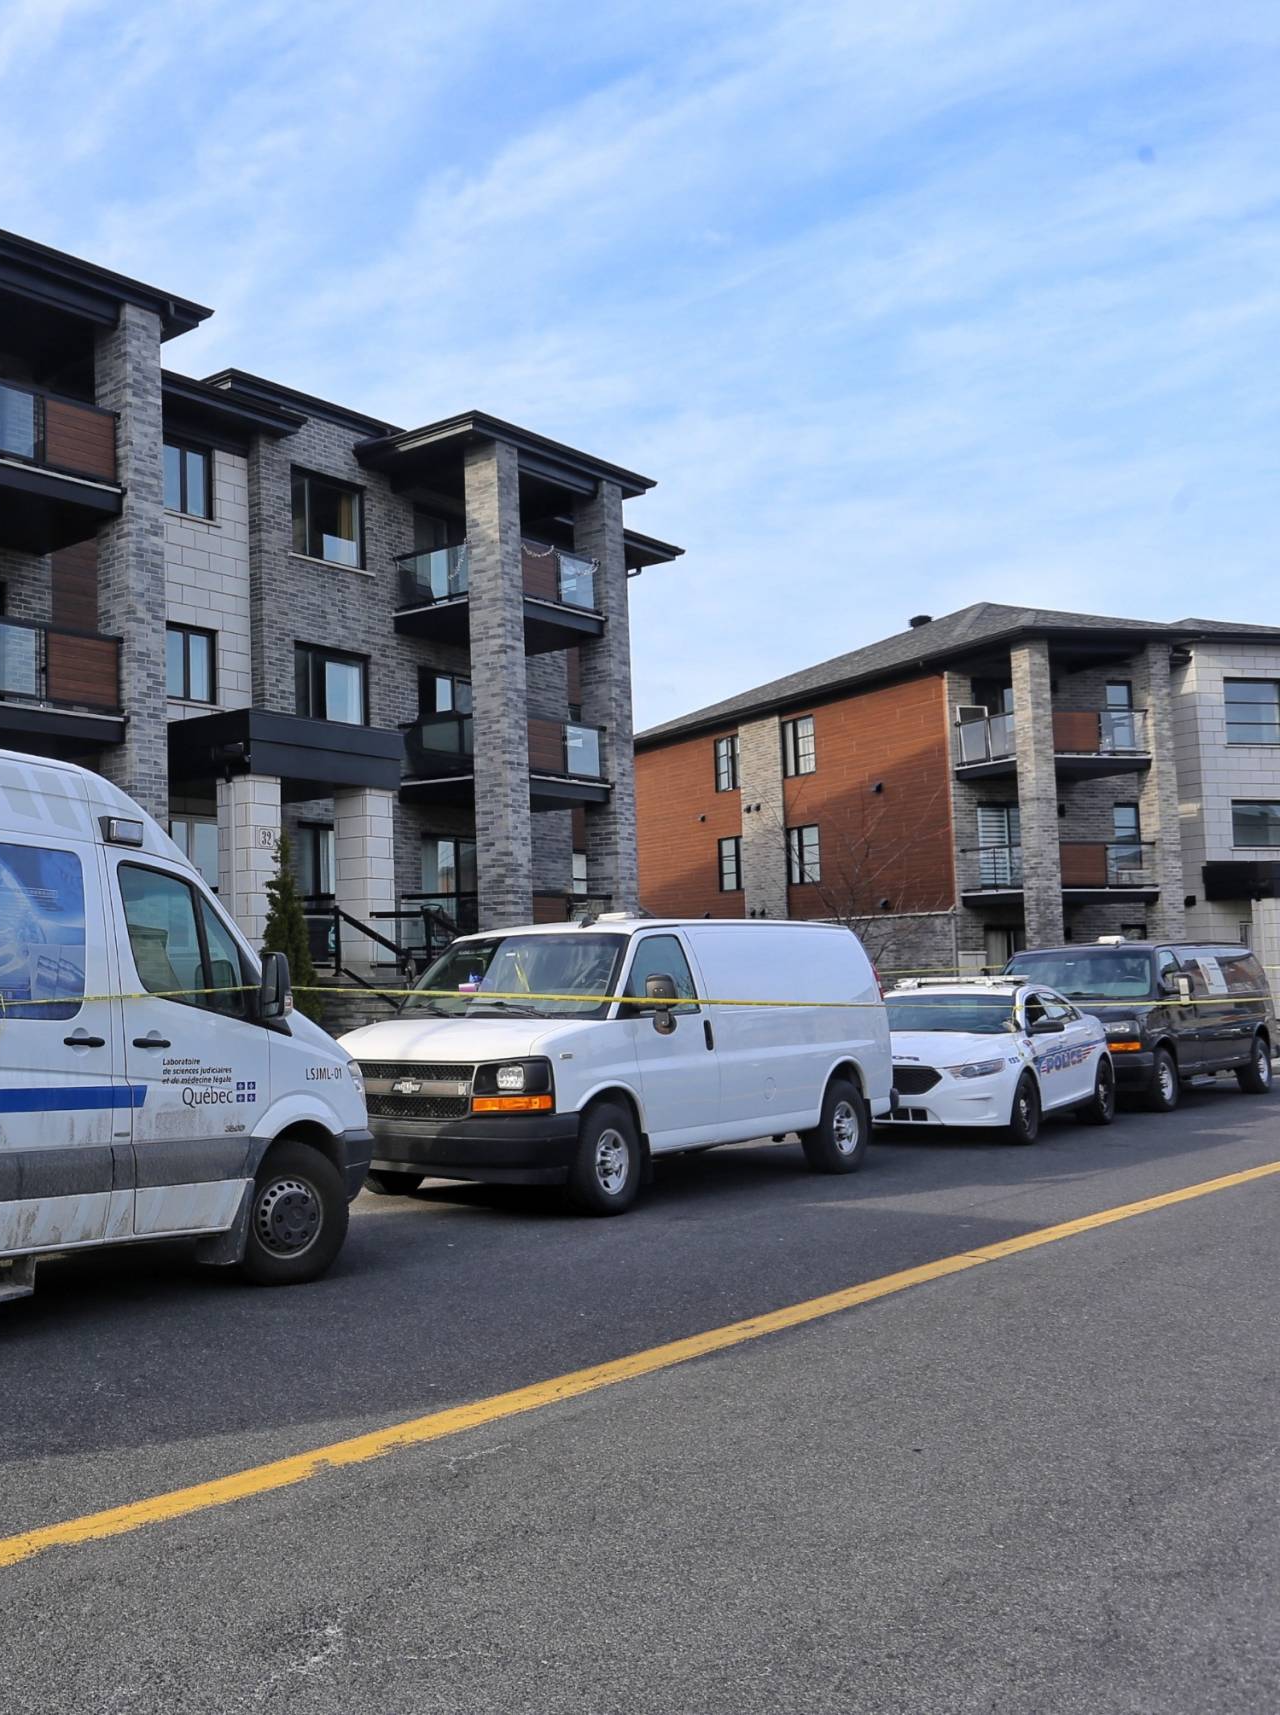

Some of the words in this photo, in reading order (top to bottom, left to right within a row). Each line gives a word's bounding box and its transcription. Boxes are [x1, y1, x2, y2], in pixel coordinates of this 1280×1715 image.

[261, 830, 272, 846] 32
[162, 1058, 200, 1066] Laboratoire
[1045, 1047, 1082, 1074] POLICE
[200, 1066, 232, 1076] judiciaires
[306, 1067, 342, 1081] LSJML-01
[182, 1086, 233, 1108] Québec
